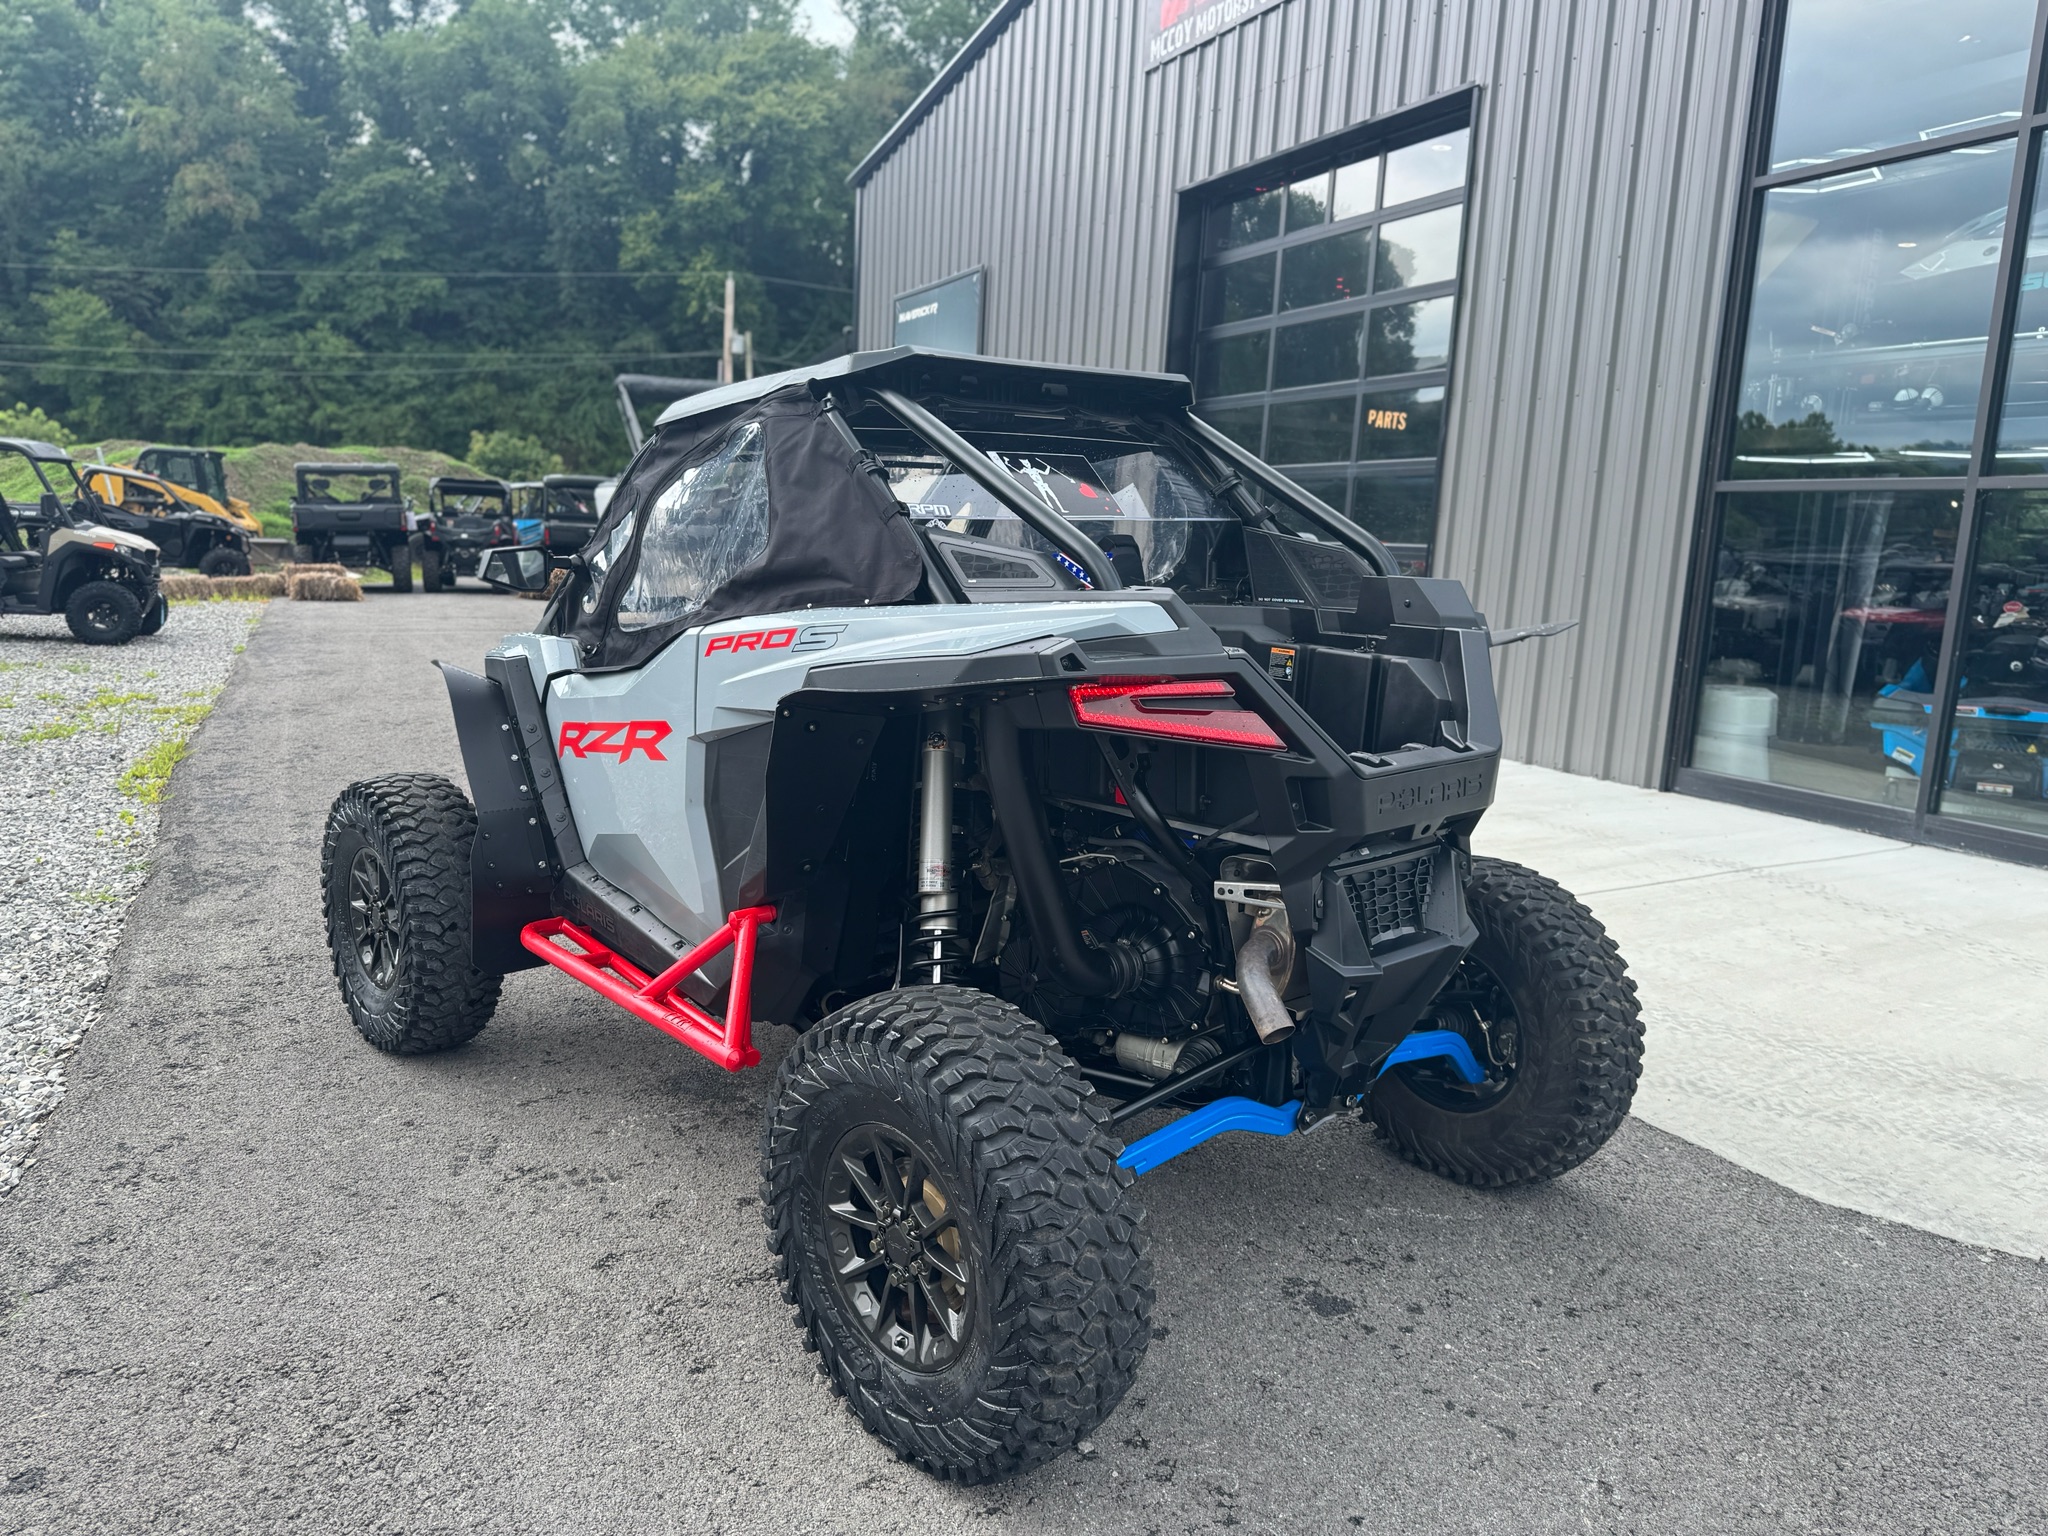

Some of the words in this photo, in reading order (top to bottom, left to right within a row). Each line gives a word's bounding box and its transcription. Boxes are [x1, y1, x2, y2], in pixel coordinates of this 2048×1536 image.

[1150, 16, 1194, 62] MCCOY
[1367, 409, 1407, 430] PARTS
[907, 503, 952, 517] RPM
[704, 627, 798, 658] PRO
[791, 623, 849, 653] S
[558, 720, 674, 765] RZR
[1378, 774, 1482, 815] POLARIS
[563, 889, 615, 933] POLARIS
